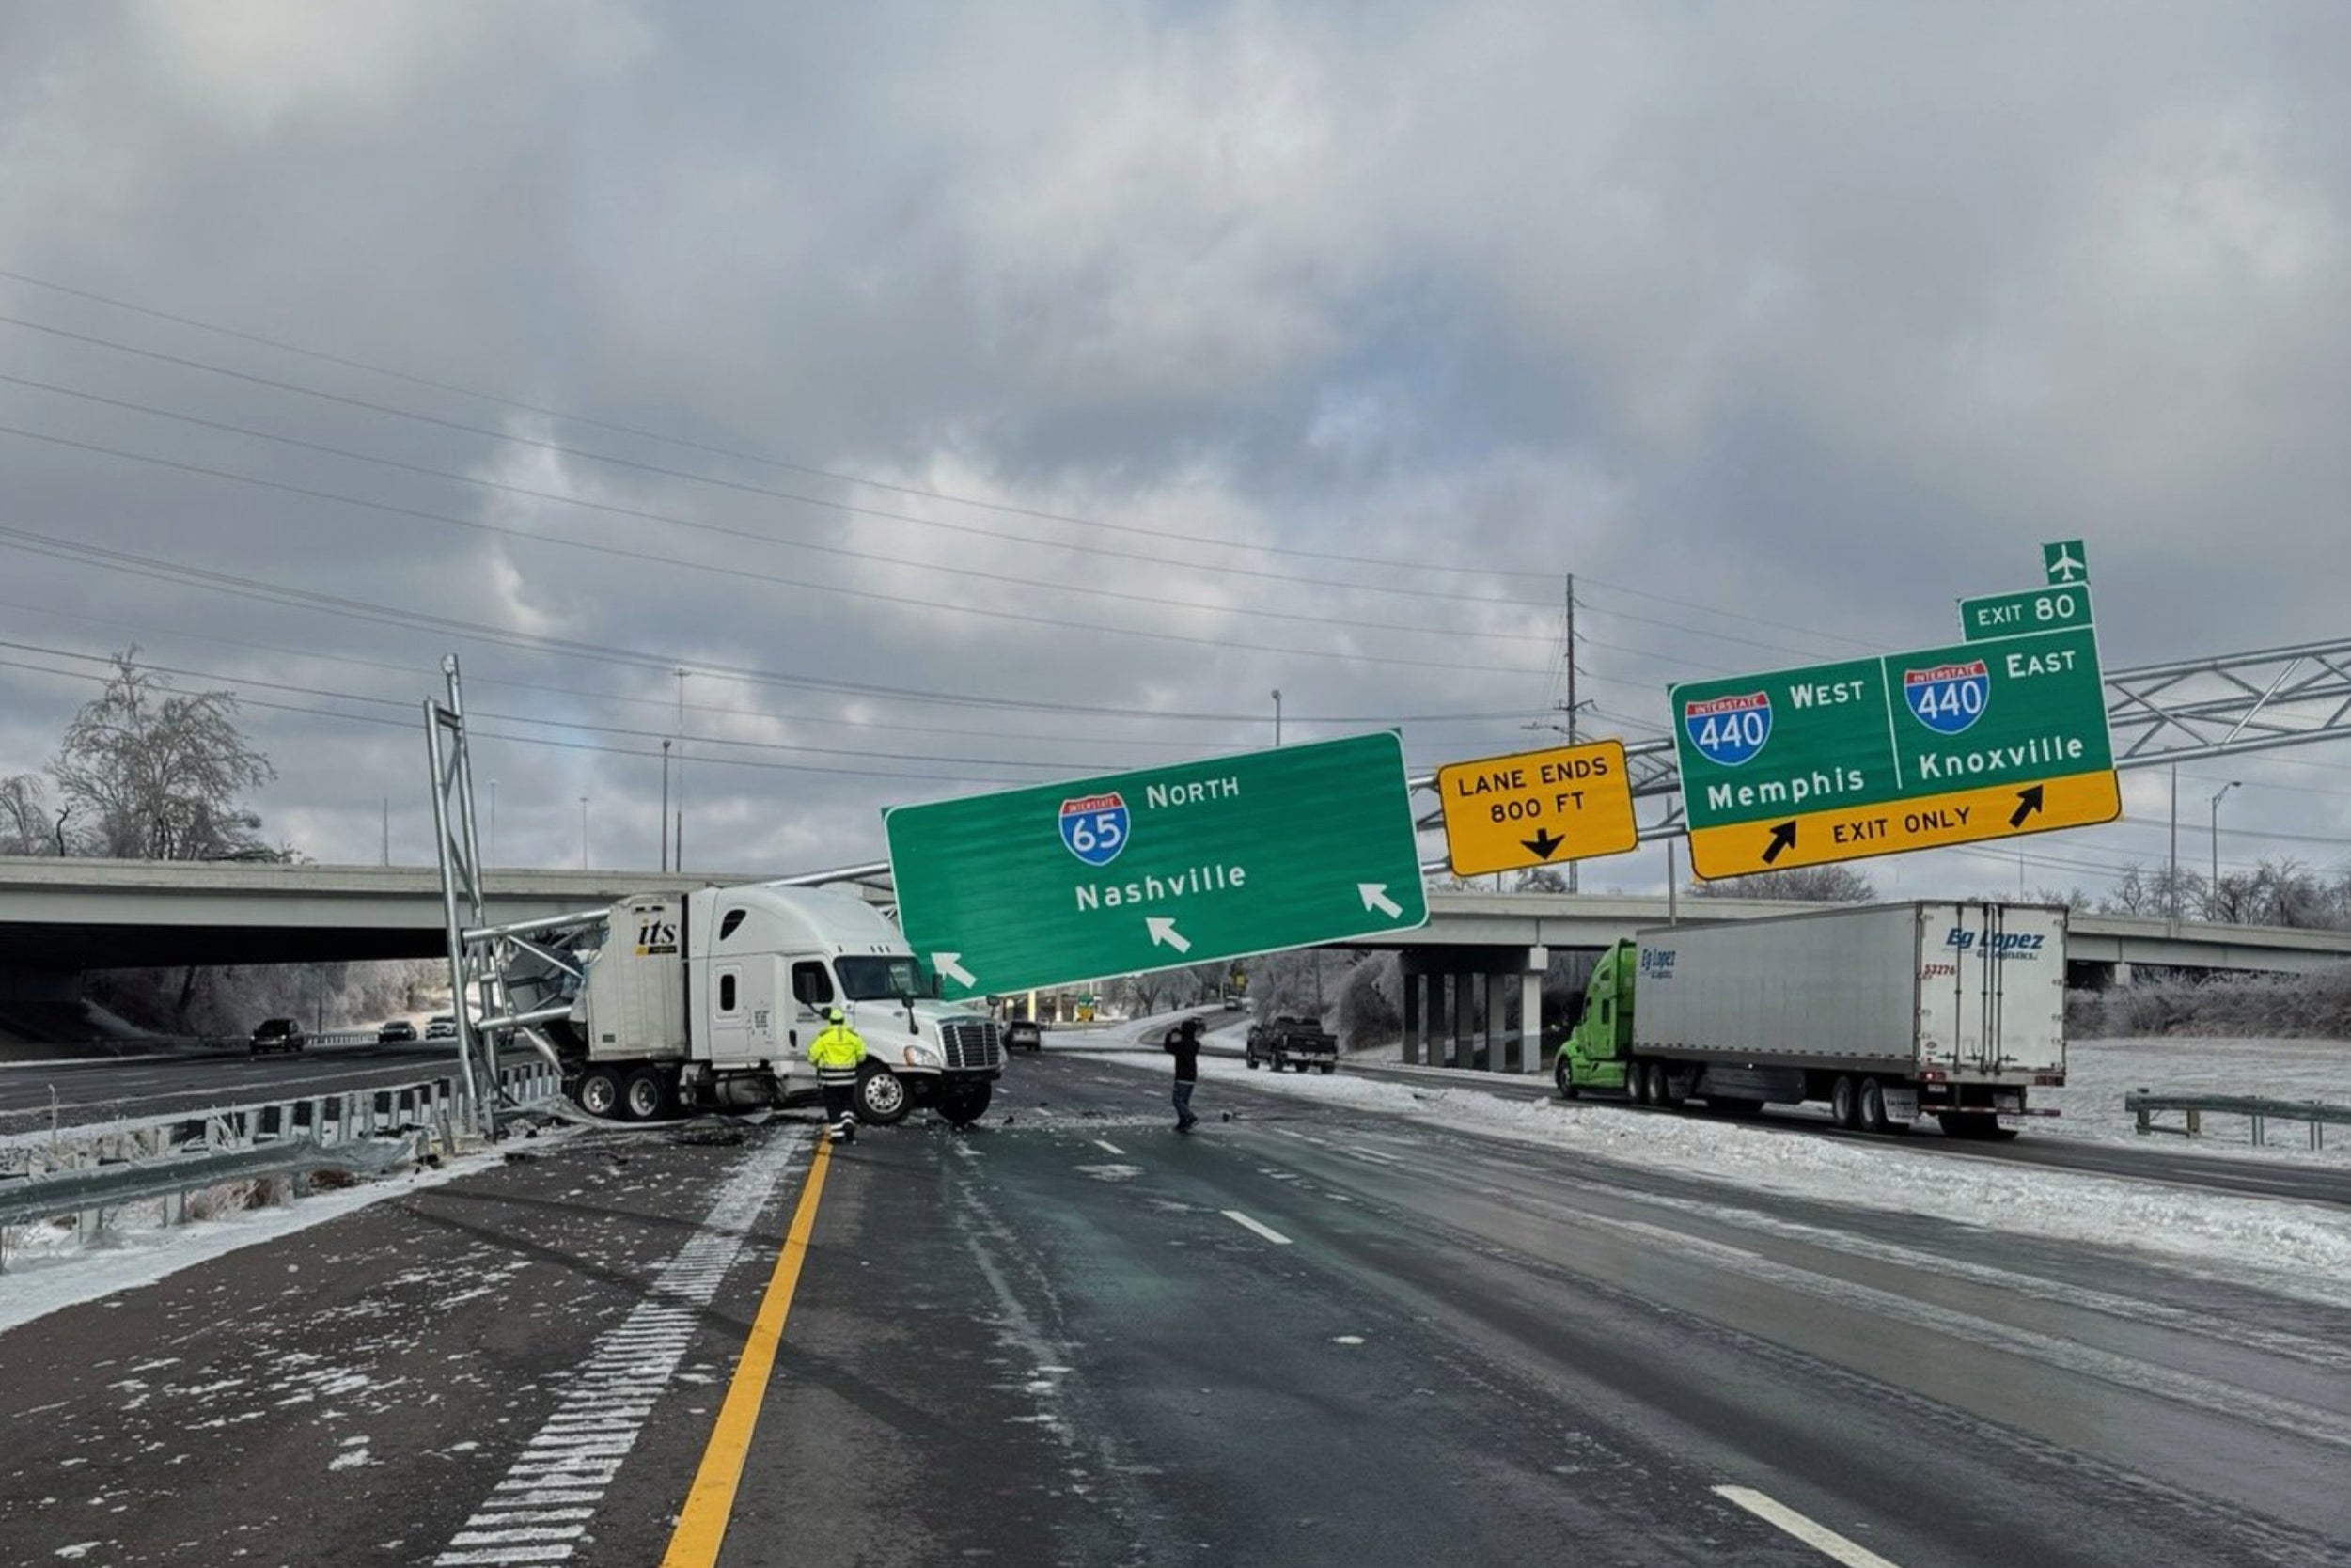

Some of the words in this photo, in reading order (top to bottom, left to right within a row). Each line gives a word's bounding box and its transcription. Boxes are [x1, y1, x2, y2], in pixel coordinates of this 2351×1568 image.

[1977, 604, 2022, 627] EXIT
[2034, 594, 2076, 621] 80
[1913, 665, 1975, 682] INTERSTATE
[2006, 651, 2076, 679] EAST
[1694, 697, 1759, 713] INTERSTATE
[1790, 681, 1864, 709] WEST
[1918, 680, 1982, 720] 440
[1699, 711, 1764, 751] 440
[1919, 735, 2084, 780] Knoxville
[1145, 776, 1240, 809] NORTH
[1458, 769, 1527, 797] LANE
[1540, 756, 1608, 785] ENDS
[1706, 767, 1864, 811] Memphis
[1068, 797, 1116, 813] INTERSTATE
[1490, 798, 1542, 823] 800
[1555, 791, 1585, 813] FT
[1072, 813, 1121, 852] 65
[1832, 818, 1889, 844] EXIT
[1904, 806, 1971, 834] ONLY
[1074, 863, 1246, 912] Nashville
[638, 917, 677, 945] its
[1978, 929, 2045, 950] Lopez
